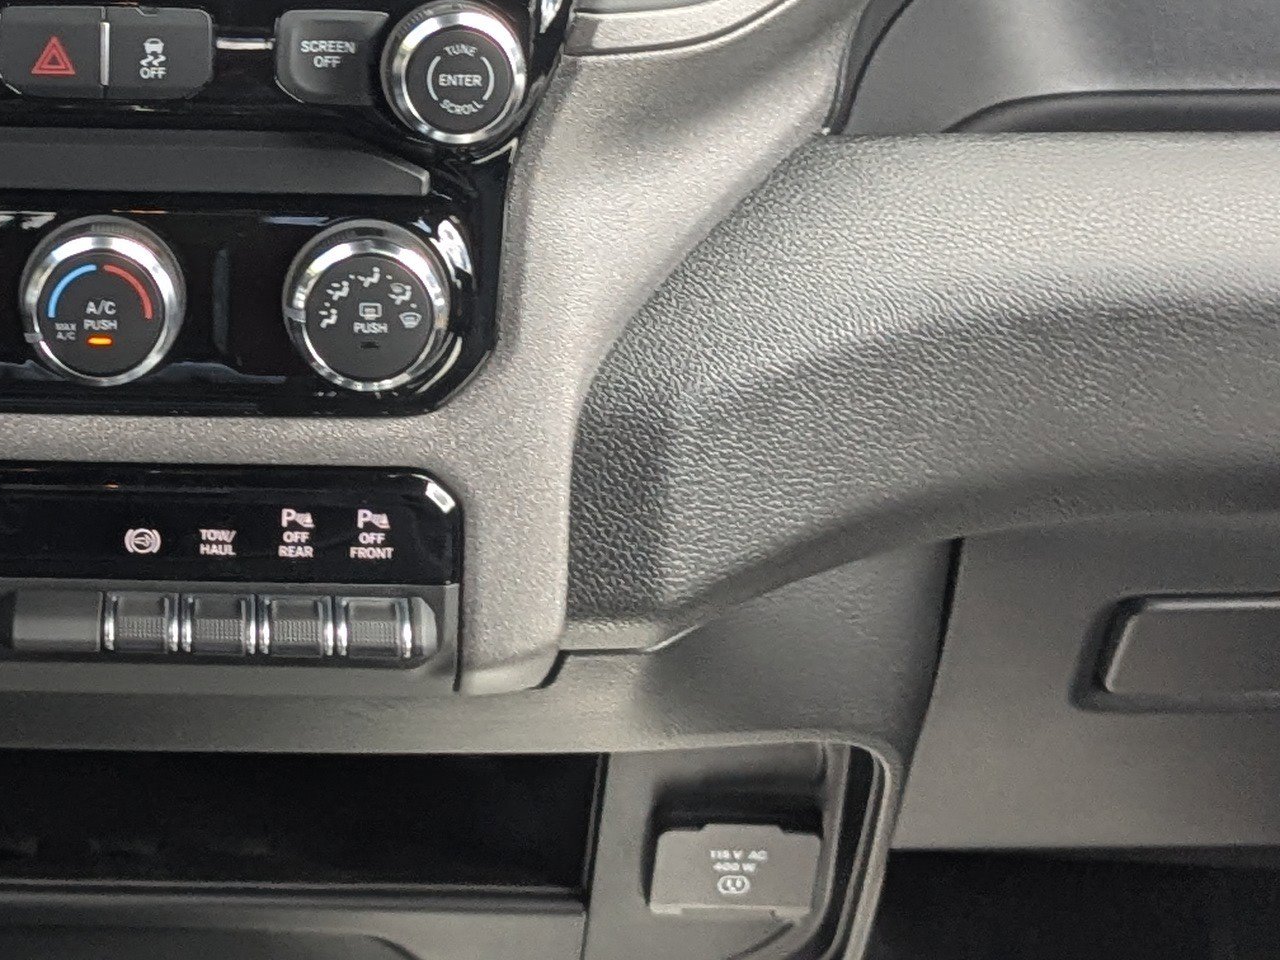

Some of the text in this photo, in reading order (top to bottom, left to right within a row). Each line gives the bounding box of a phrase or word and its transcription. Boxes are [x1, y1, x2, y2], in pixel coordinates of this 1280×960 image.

[300, 40, 356, 55] SCREEN
[443, 43, 478, 57] TUNE
[313, 55, 342, 69] OFF
[139, 66, 167, 80] OFF
[438, 74, 482, 87] ENTER
[439, 99, 484, 115] SCROLL
[85, 299, 117, 315] A/C
[83, 319, 118, 331] PUSH
[353, 322, 388, 334] PUSH
[199, 528, 237, 541] TOW/
[283, 531, 310, 544] OFF
[358, 532, 385, 545] OFF
[200, 543, 236, 556] HAUL
[278, 545, 313, 558] REAR
[349, 546, 394, 560] FRONT
